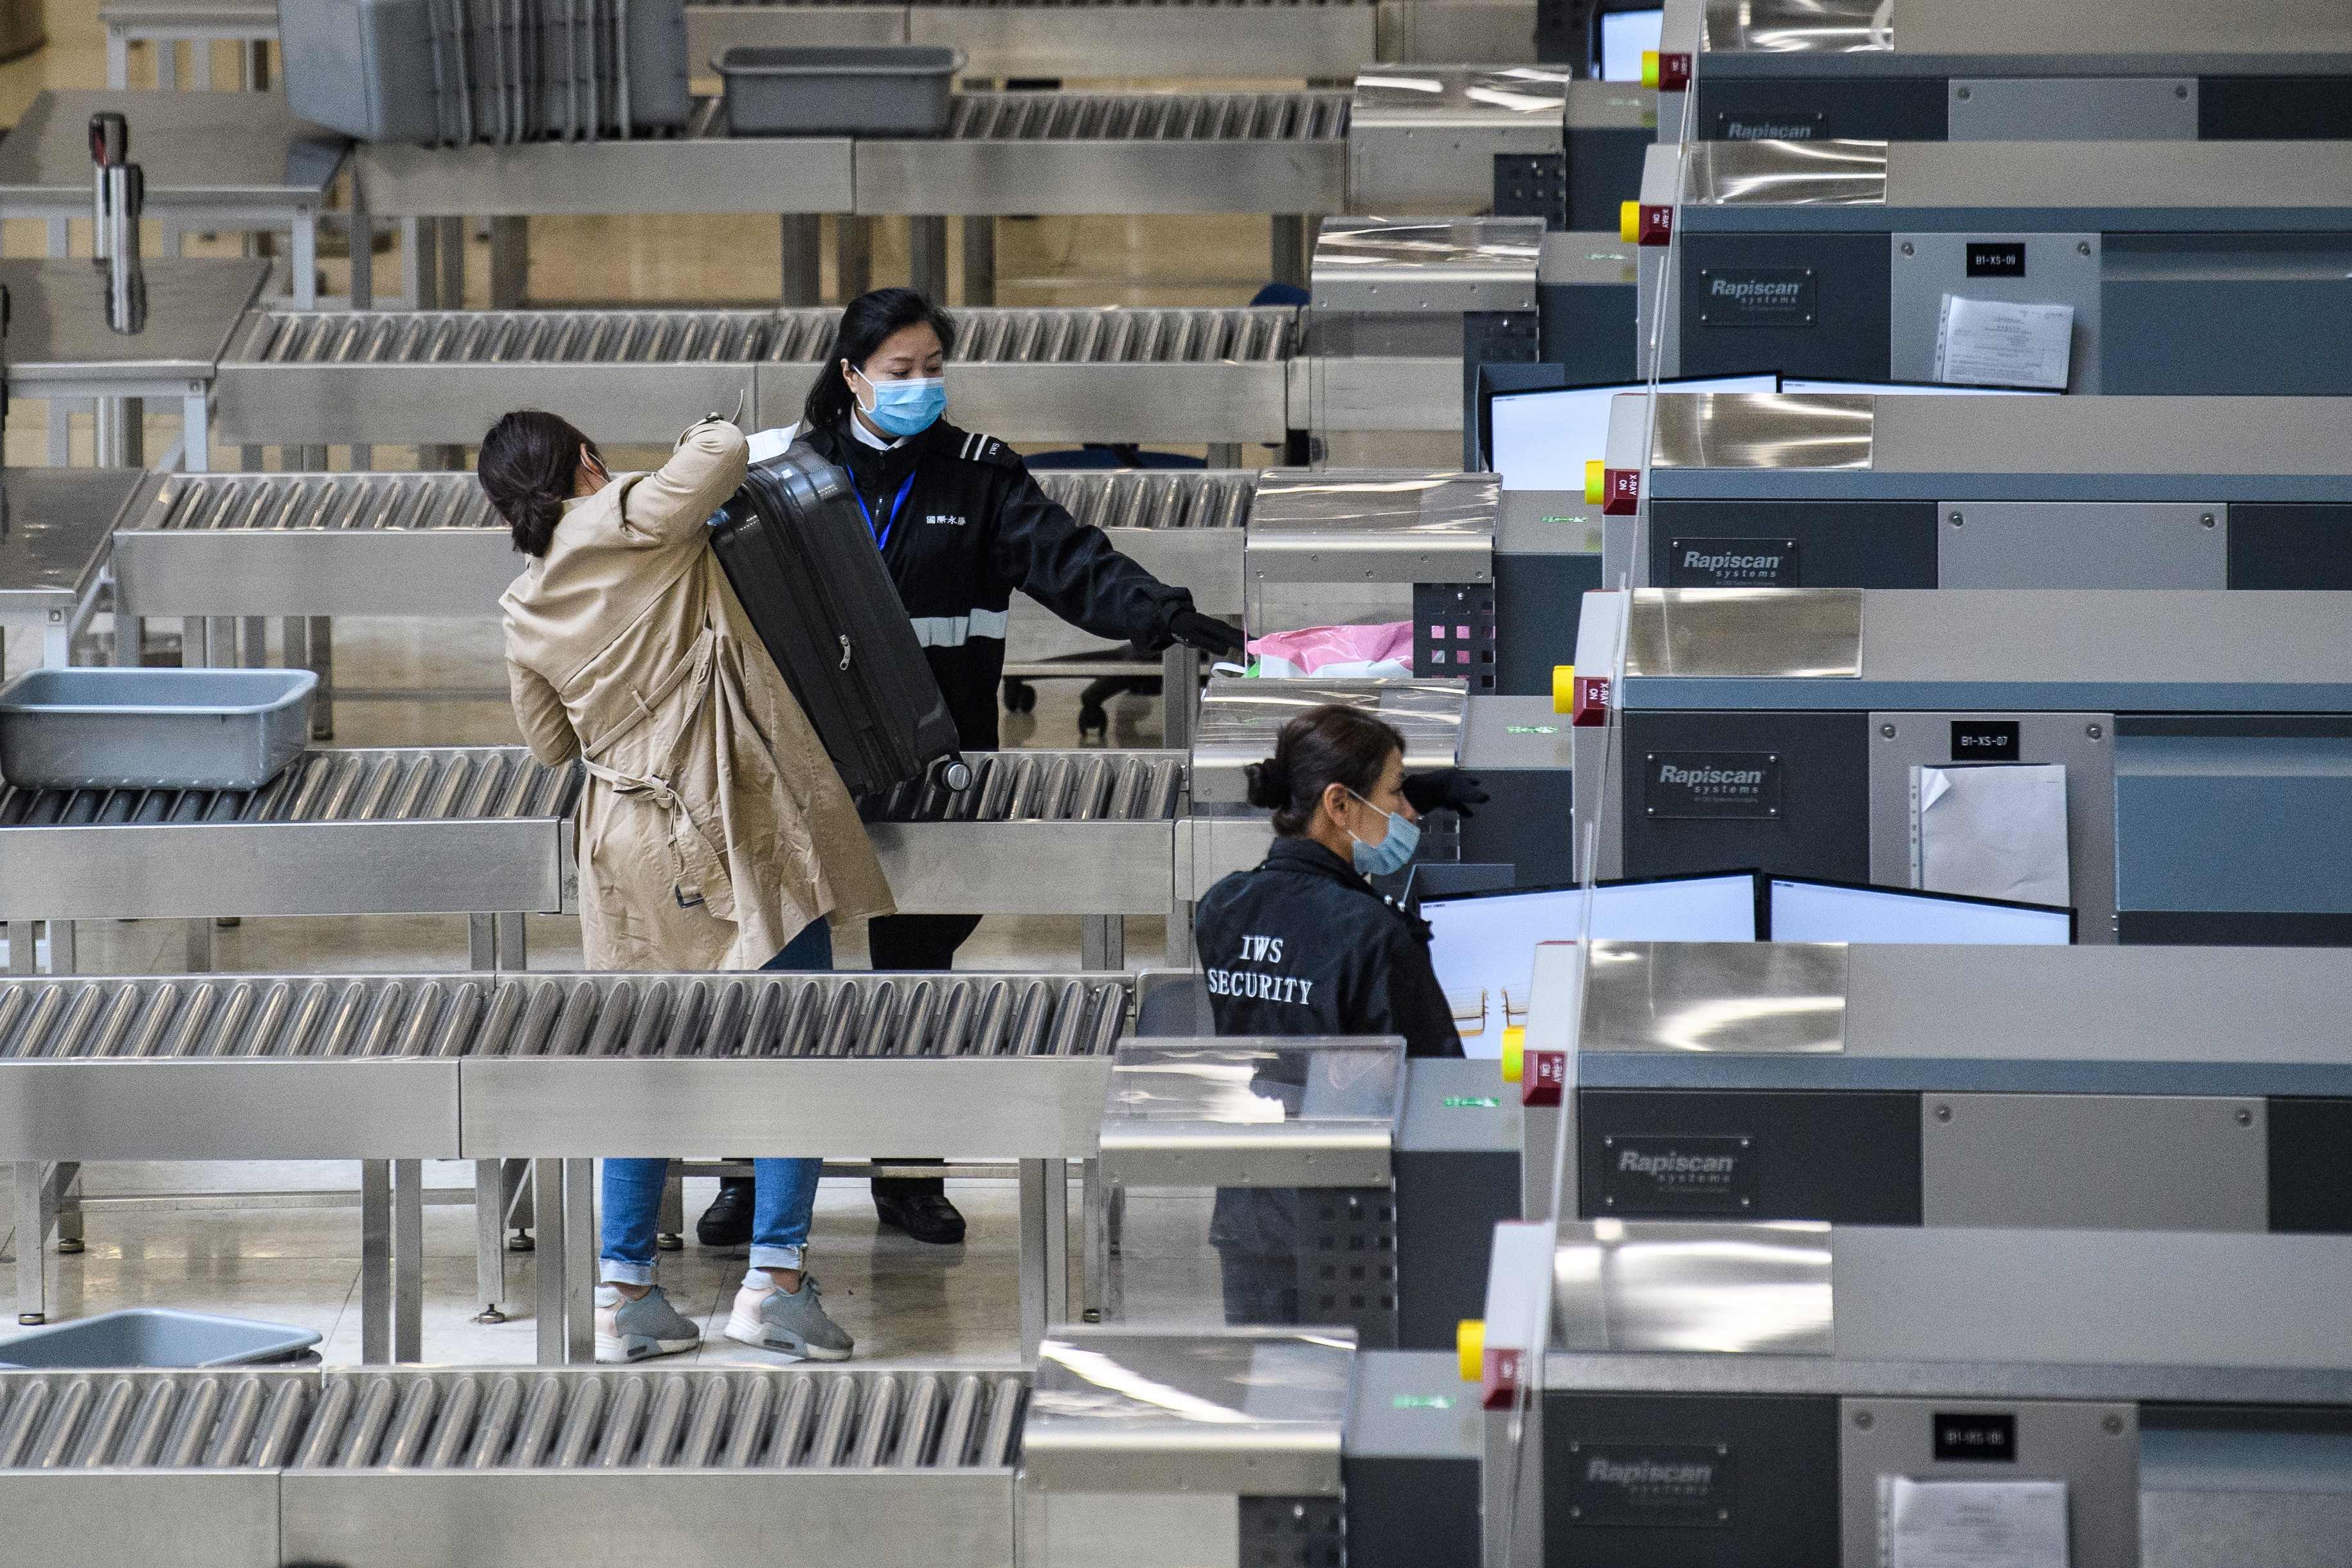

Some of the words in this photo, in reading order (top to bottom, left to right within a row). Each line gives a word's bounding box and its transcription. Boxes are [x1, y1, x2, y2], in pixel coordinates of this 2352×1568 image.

[1728, 123, 1811, 140] Rapiscan
[1712, 279, 1799, 298] Rapiscan
[989, 443, 1000, 455] IWS
[1619, 480, 1627, 491] ON
[1683, 551, 1779, 572] Rapiscan
[1716, 570, 1776, 579] systems
[1589, 689, 1598, 699] ON
[1600, 683, 1609, 705] X-RAY
[1961, 736, 2007, 746] B1-XS-07
[1660, 765, 1762, 787] Rapiscan
[1694, 786, 1759, 795] systems
[1239, 935, 1283, 963] IWS
[1208, 968, 1313, 1004] SECURITY
[1618, 1150, 1734, 1176] Rapiscan
[1589, 1459, 1713, 1486] Rapiscan
